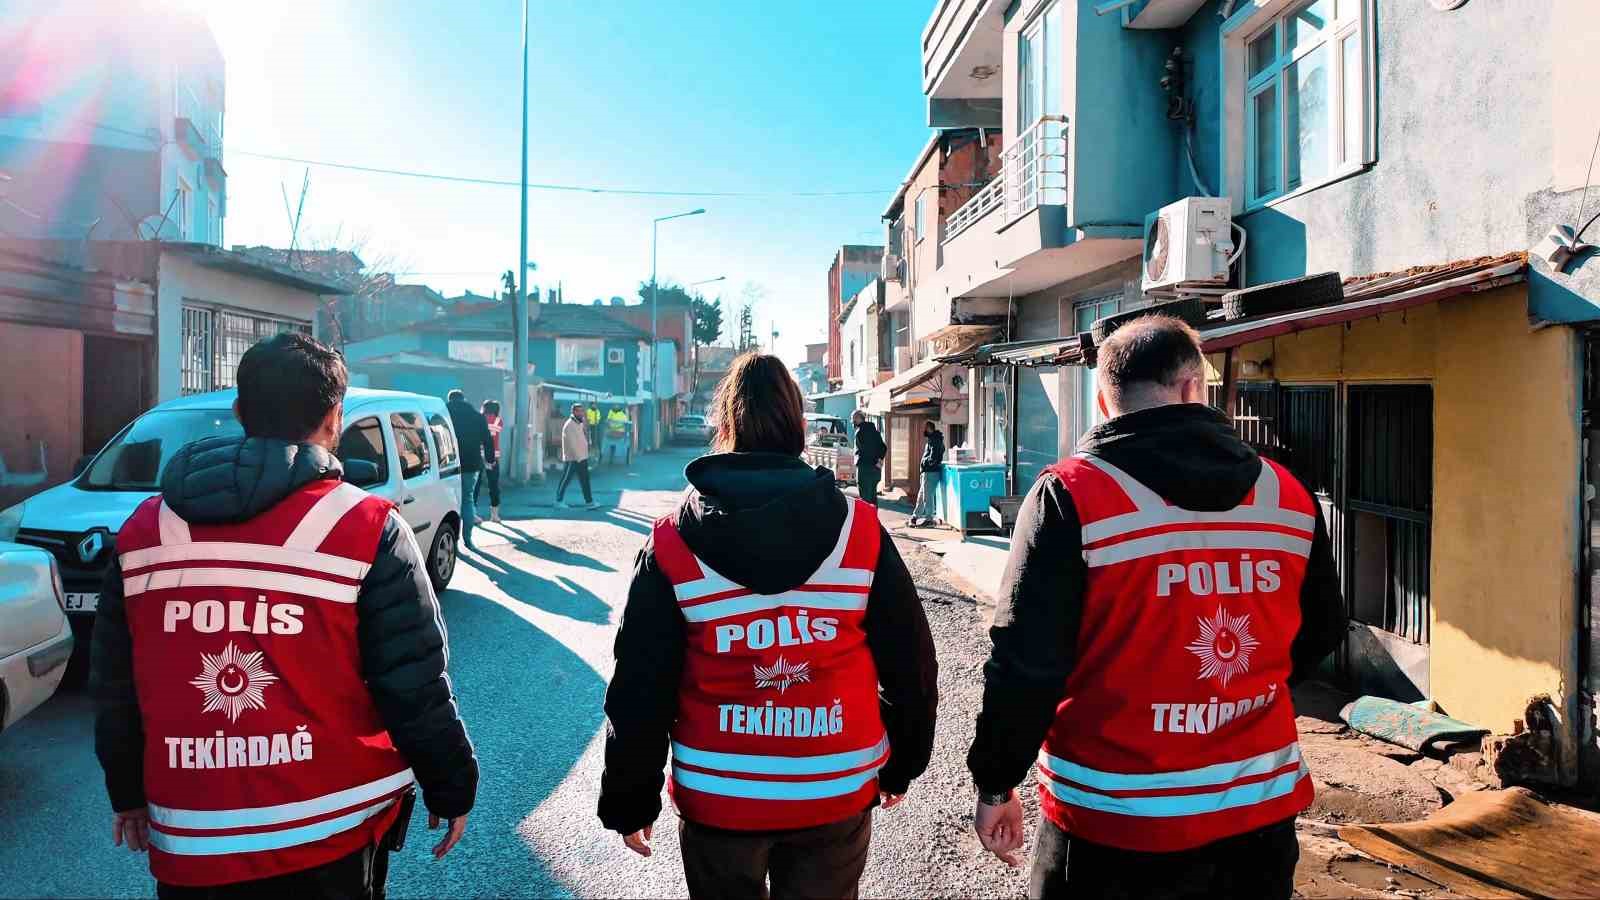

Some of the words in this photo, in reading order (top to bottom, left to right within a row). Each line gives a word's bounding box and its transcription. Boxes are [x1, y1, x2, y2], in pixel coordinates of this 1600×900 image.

[1156, 553, 1281, 597] POLİS
[66, 594, 84, 609] EJ
[163, 595, 305, 635] POLİS
[715, 609, 839, 654] POLİS
[718, 698, 843, 738] TEKİRDAĞ
[164, 724, 313, 769] TEKİRDAĞ
